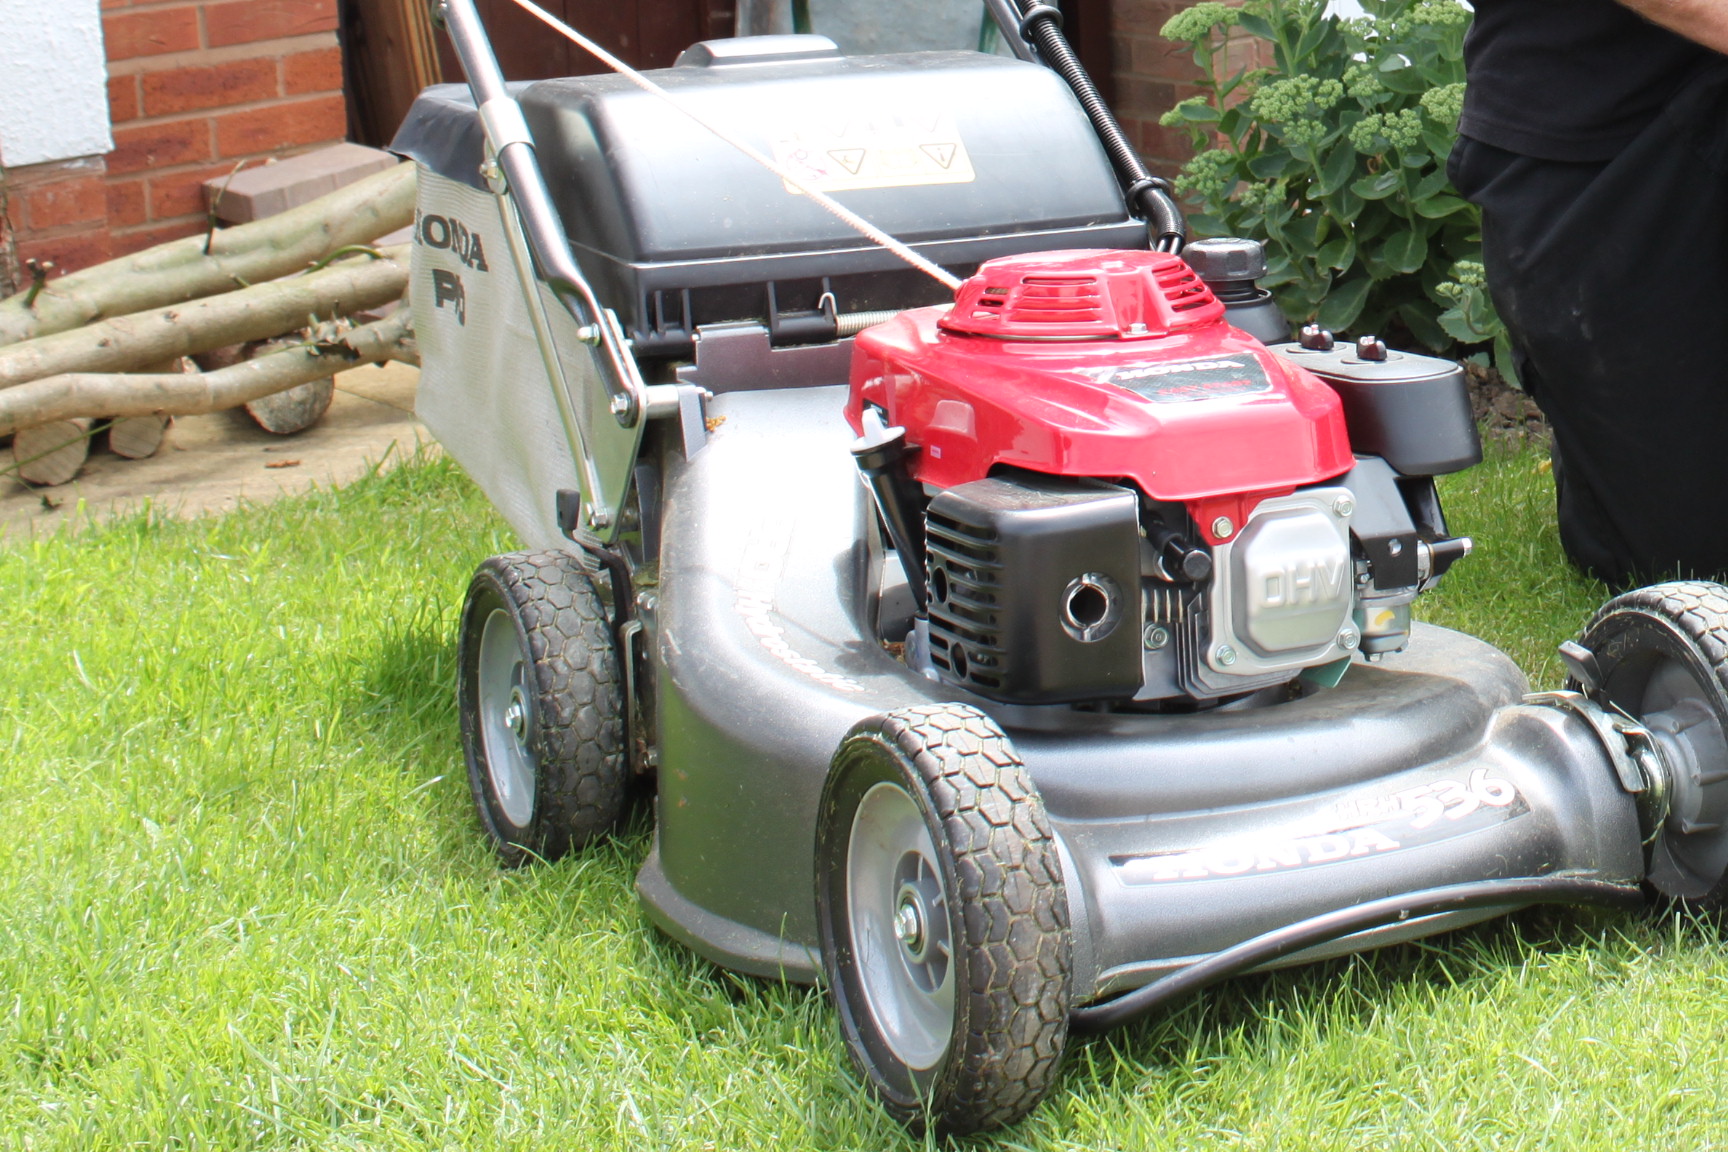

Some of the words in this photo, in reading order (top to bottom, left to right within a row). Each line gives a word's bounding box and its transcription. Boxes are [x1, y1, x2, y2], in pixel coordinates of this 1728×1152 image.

[1115, 360, 1246, 381] HONDA
[1262, 557, 1345, 607] OHV
[1151, 828, 1401, 881] HONDA
